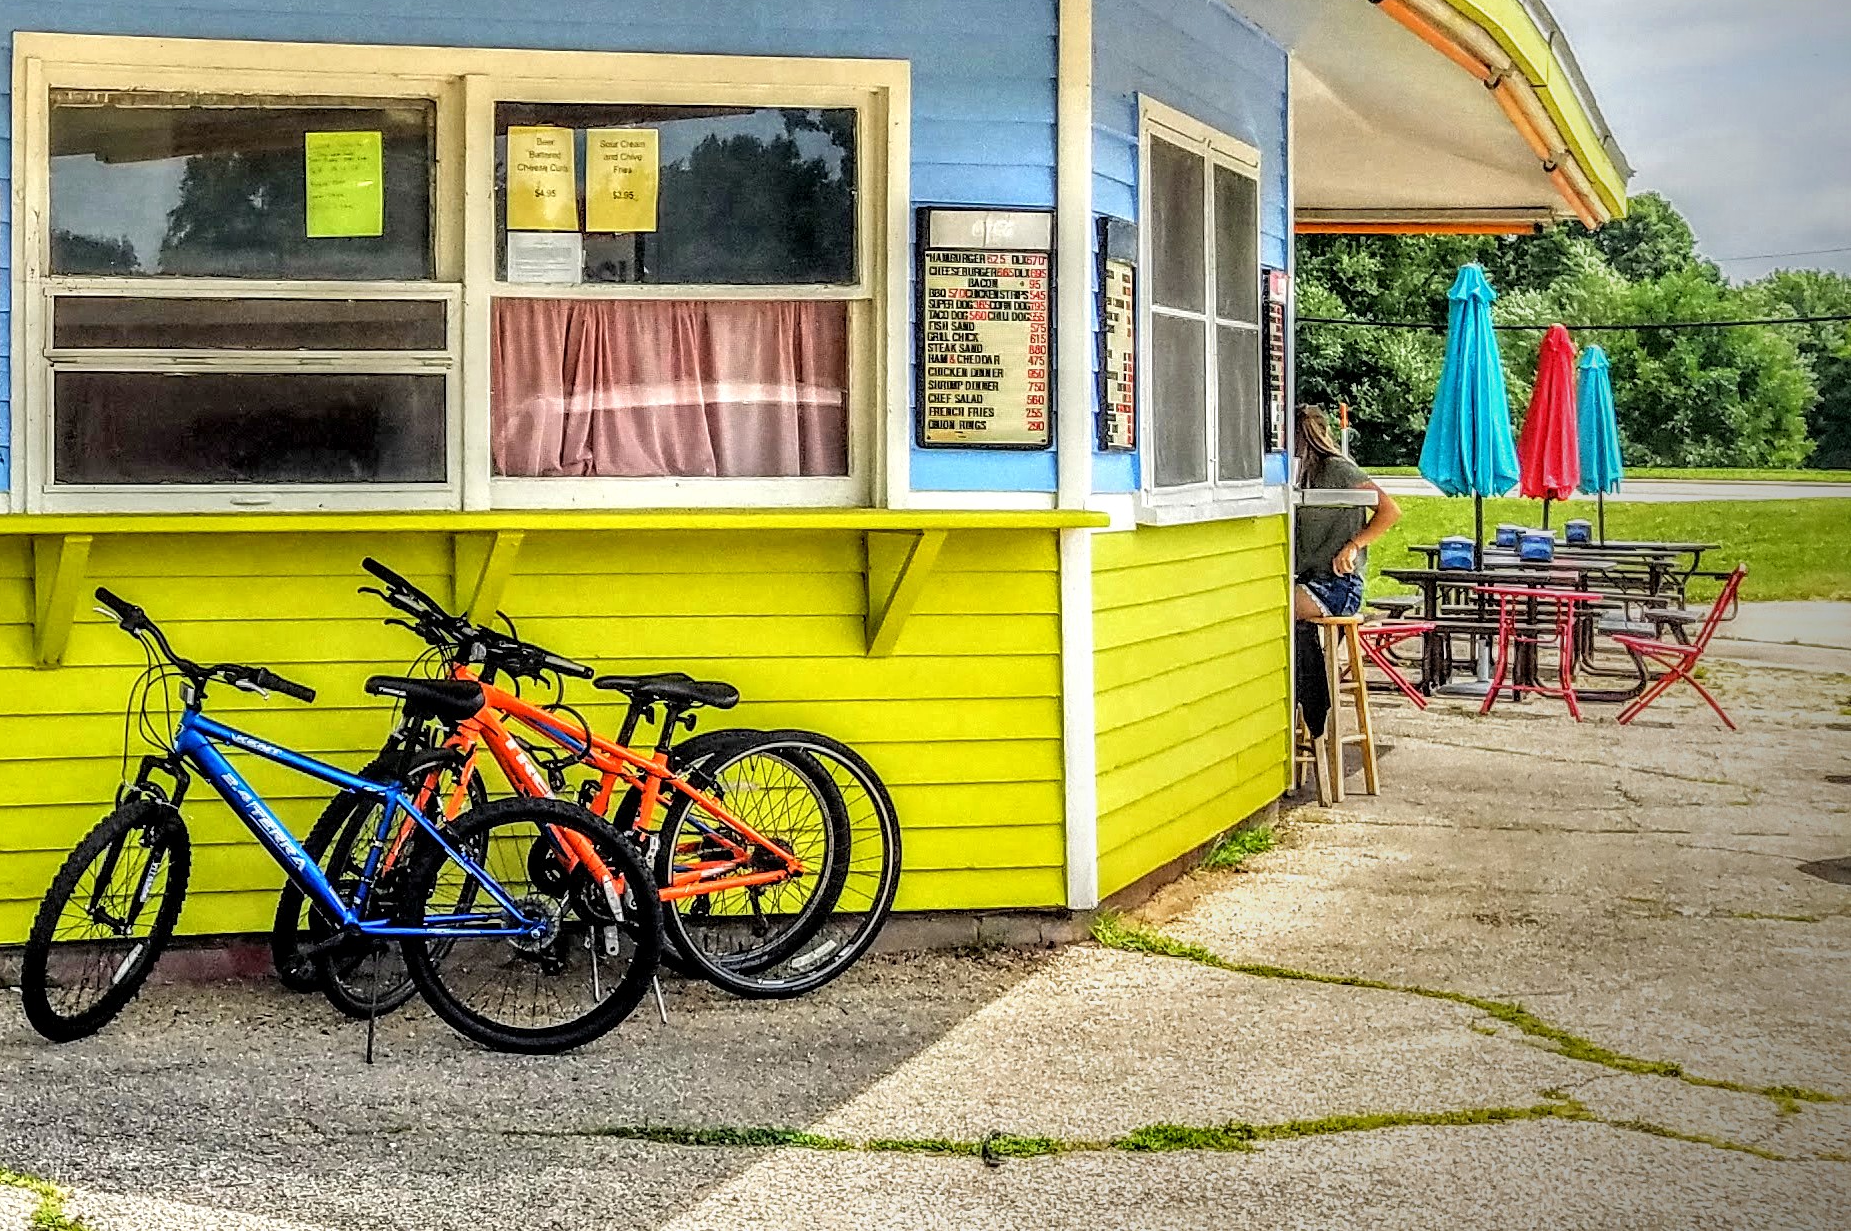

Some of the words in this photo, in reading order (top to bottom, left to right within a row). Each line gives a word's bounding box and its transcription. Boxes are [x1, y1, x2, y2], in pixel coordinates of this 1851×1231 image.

[600, 139, 618, 148] Sour
[620, 140, 645, 148] Cream
[603, 152, 618, 161] and
[929, 253, 986, 264] HAMBURGER
[968, 278, 998, 288] BACON
[928, 310, 949, 320] TACO
[951, 311, 968, 320] DOG
[929, 321, 949, 331] FISH
[928, 343, 957, 353] STEAK
[928, 354, 948, 364] HAM
[957, 355, 1000, 365] CHEDDAR
[928, 367, 968, 377] CHICKEN
[965, 381, 999, 391] DINNER
[928, 394, 952, 403] CHEF
[955, 394, 983, 404] SALAD
[929, 407, 964, 417] FRENCH
[968, 408, 995, 417] FRIES
[245, 800, 306, 874] TERRA
